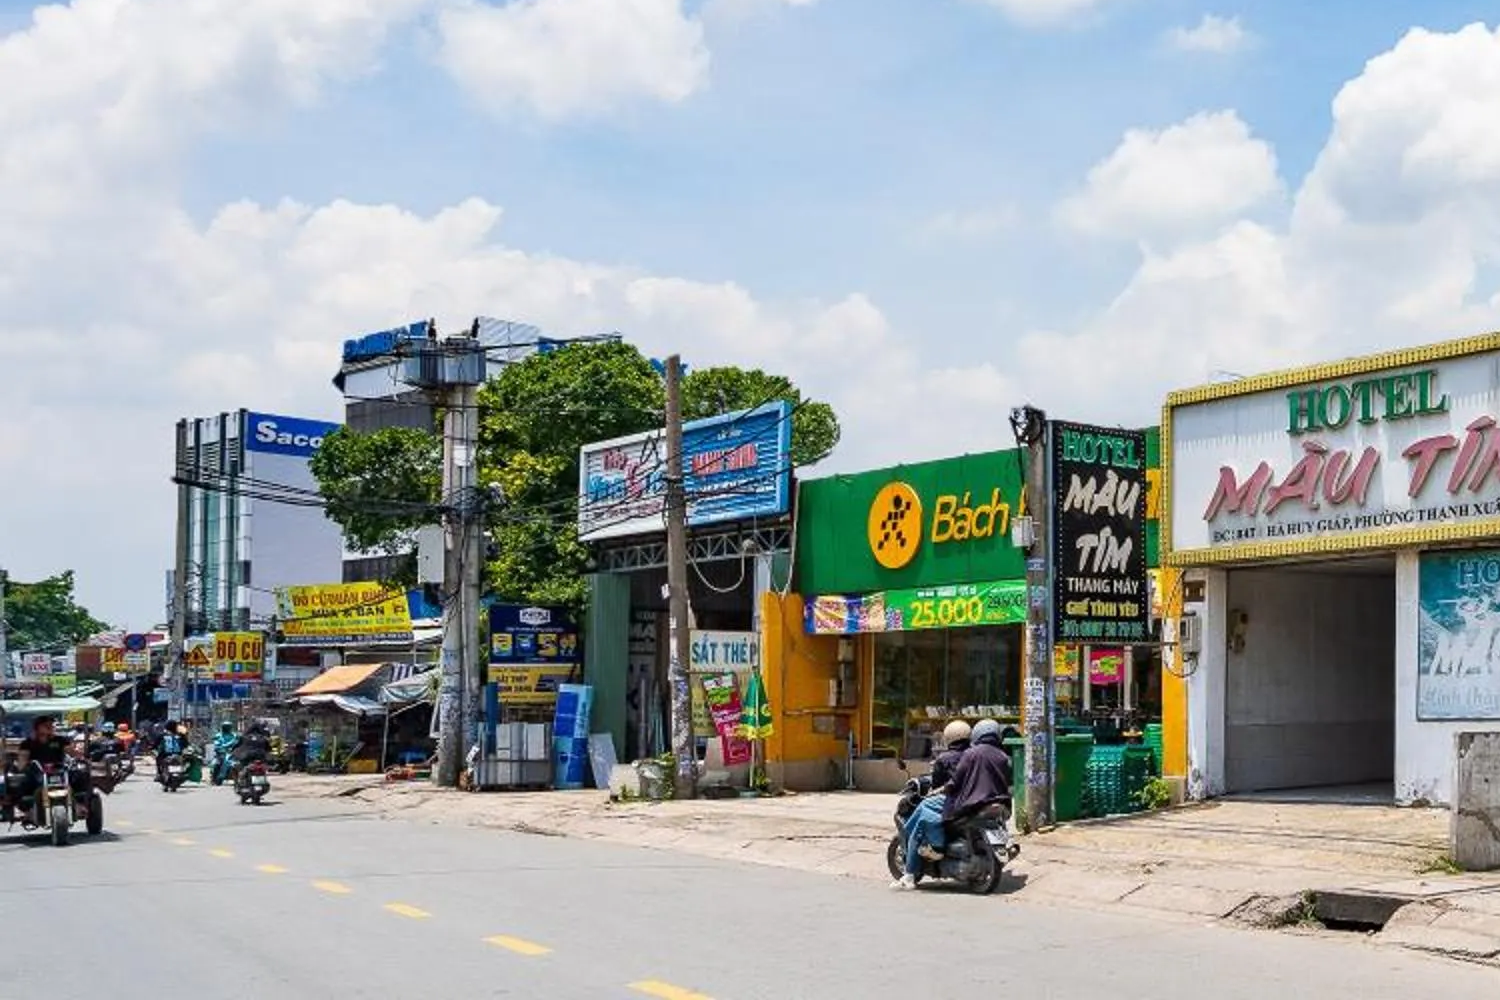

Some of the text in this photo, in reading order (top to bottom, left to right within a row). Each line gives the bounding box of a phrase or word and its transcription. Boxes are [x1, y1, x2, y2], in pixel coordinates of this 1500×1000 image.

[1286, 370, 1449, 434] HOTEL
[1063, 430, 1141, 468] HOTEL
[932, 488, 1010, 543] Bách
[1287, 520, 1314, 536] HUY
[1076, 526, 1132, 574] TÍM
[1066, 577, 1111, 593] THANG
[911, 597, 984, 628] 25.000
[691, 633, 757, 665] SẮT THÉP
